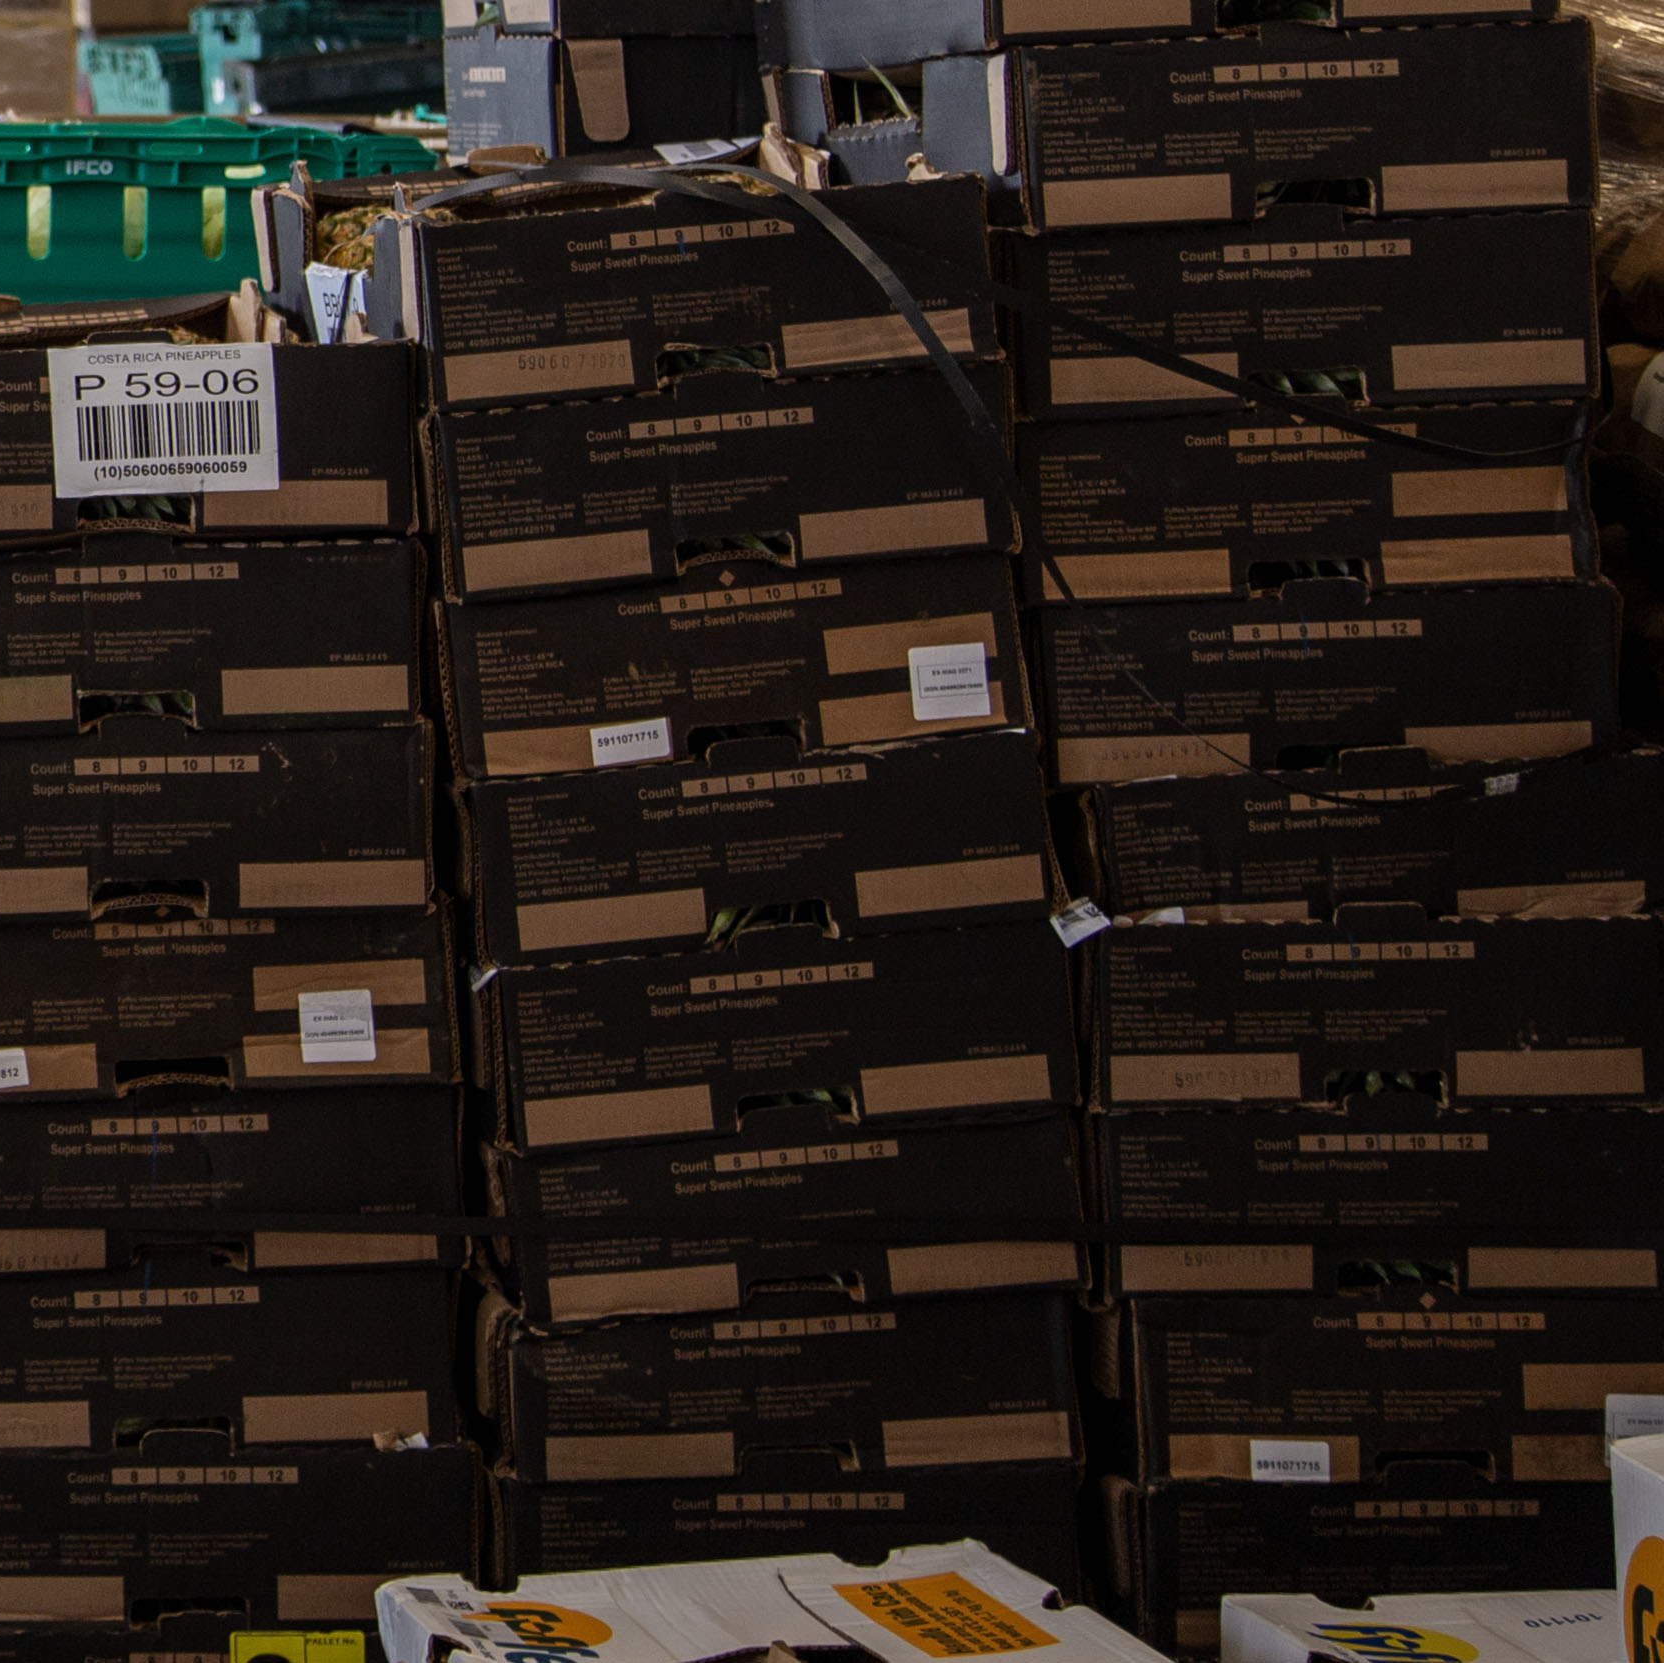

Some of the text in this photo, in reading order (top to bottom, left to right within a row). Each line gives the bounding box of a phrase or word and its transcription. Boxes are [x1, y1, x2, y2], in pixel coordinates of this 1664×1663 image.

[1170, 61, 1384, 84] Count: 8 9 10 12
[1173, 86, 1303, 106] Super Sweet Pineapples
[65, 161, 113, 175] IFCO
[567, 238, 608, 252] Count:
[629, 233, 636, 246] 8
[717, 225, 734, 238] 10
[764, 221, 781, 235] 12
[570, 249, 699, 273] Super Sweet Pineapples
[1180, 242, 1396, 263] Count: 8 9 10 12
[1182, 266, 1312, 285] Super Sweet Pineapples
[88, 349, 241, 365] COSTA RICA PINEAPPLES
[74, 368, 260, 400] P 59-06
[586, 410, 799, 443] Count: 8 9 10 12
[589, 439, 717, 463] Super Sweet Pineapples
[94, 460, 248, 482] (10)50600659060059
[12, 566, 224, 585] Count: 8 9 10 12
[15, 589, 142, 605] Super Sweet Pineapples
[618, 583, 827, 616] Count: 8 9 10 12
[670, 606, 795, 631] Super Sweet Pineapples
[597, 730, 659, 747] 5911071715
[30, 758, 245, 777] Count: 8 9 10 12
[33, 781, 162, 797] Super Sweet Pineapples
[638, 767, 852, 801] Count: 8 9 10 12
[642, 797, 771, 820] Super Sweet Pineapples
[47, 1117, 254, 1137] Count: 8 9 10 12
[50, 1141, 175, 1157] Super Sweet Pineapples
[1256, 1459, 1321, 1471] 5911071715
